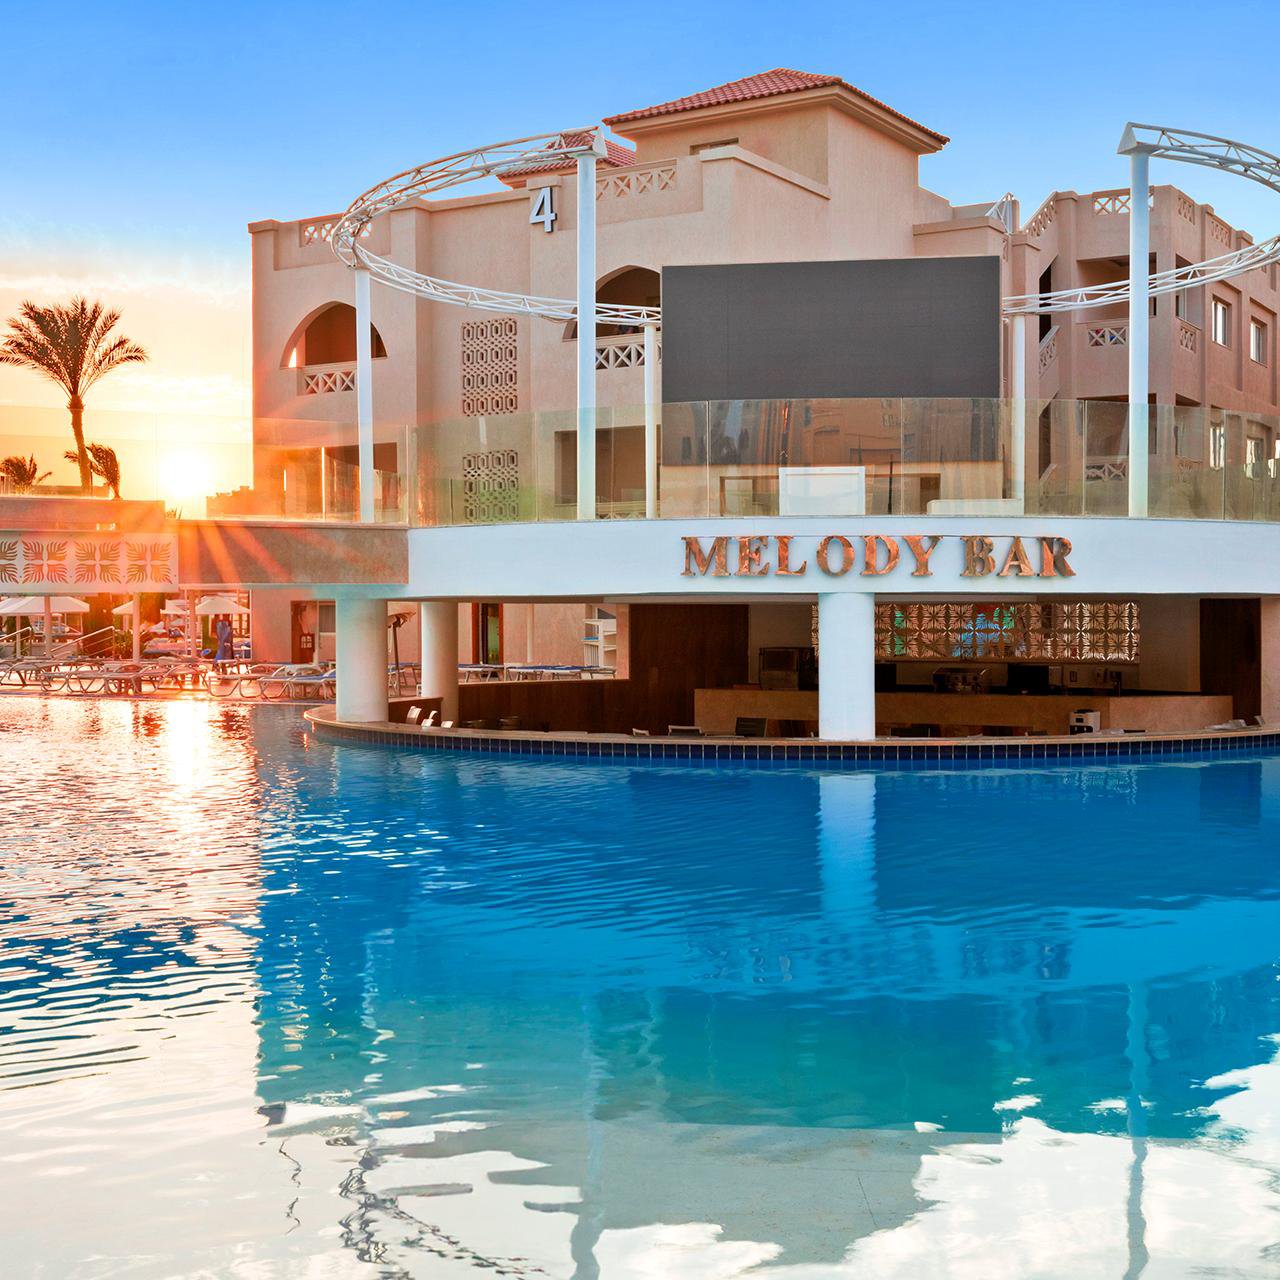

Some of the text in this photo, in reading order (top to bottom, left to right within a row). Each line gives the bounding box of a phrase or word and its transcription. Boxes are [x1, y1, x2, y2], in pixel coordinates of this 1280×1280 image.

[529, 186, 557, 232] 4
[680, 535, 1077, 577] MELODY BAR
